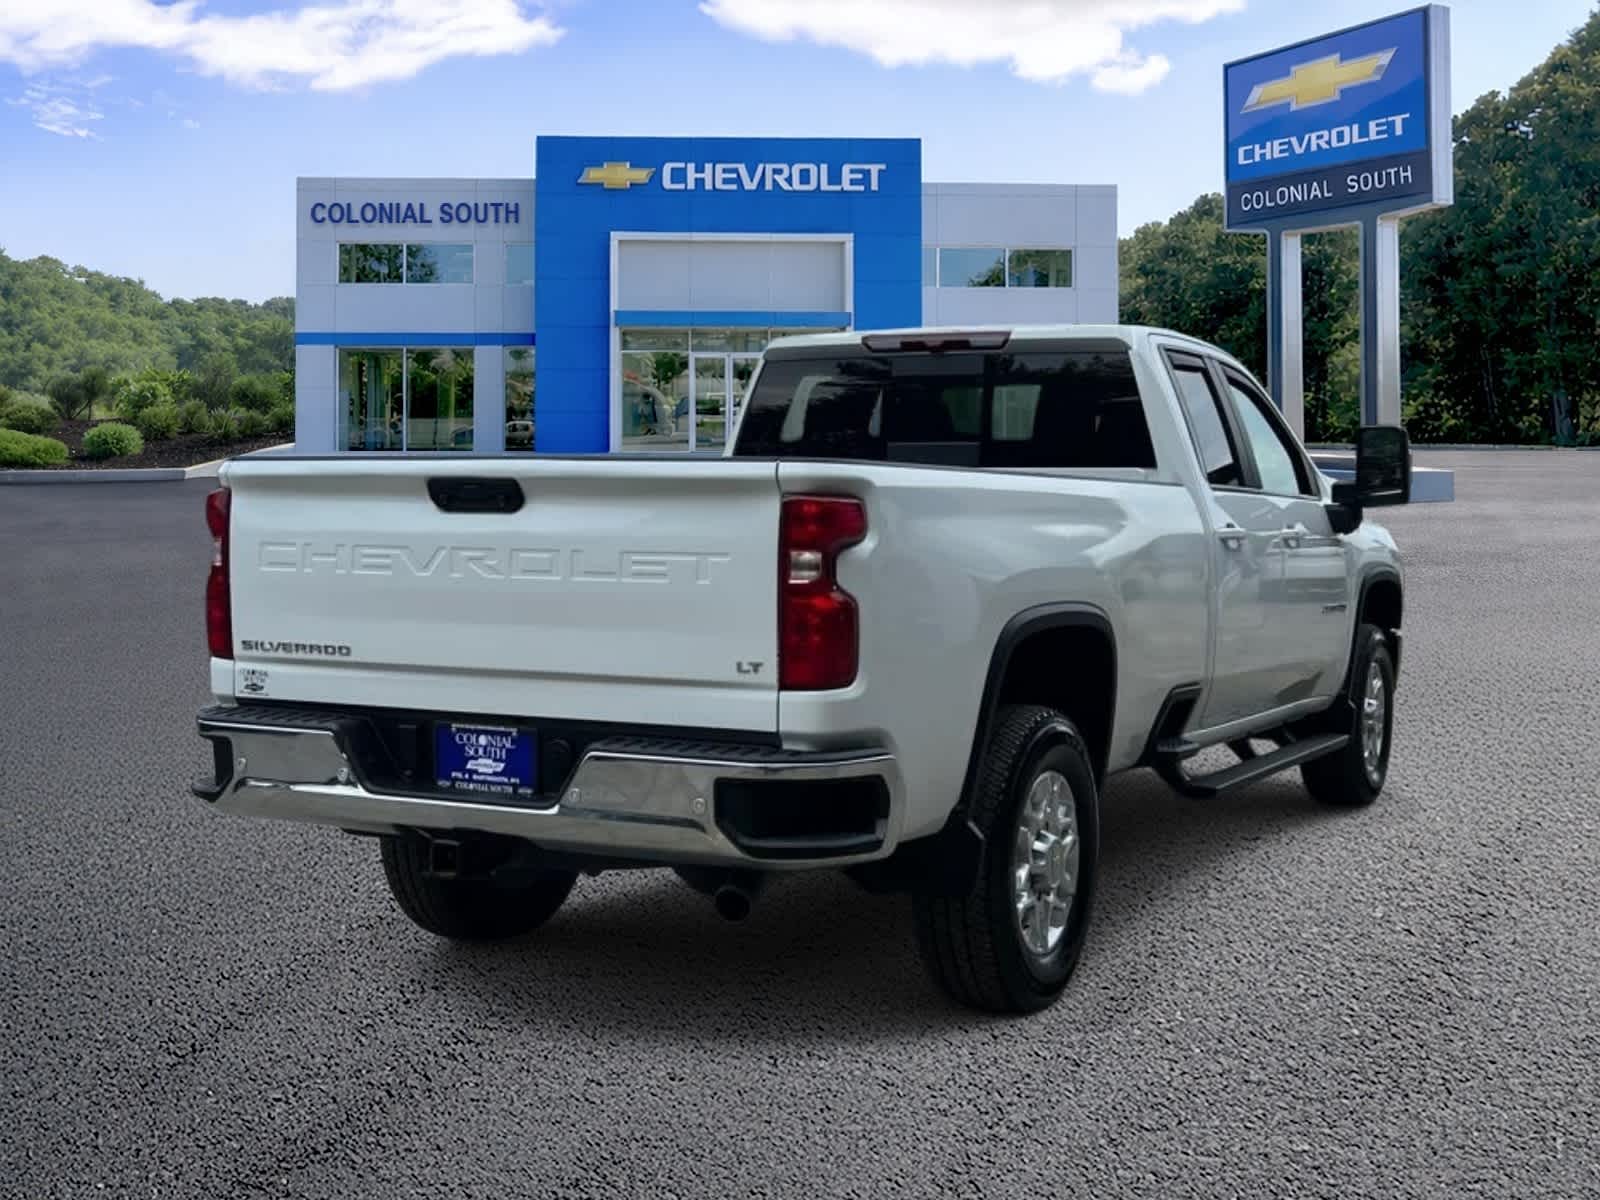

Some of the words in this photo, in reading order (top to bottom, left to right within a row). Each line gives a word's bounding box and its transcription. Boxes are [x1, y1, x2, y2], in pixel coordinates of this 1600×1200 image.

[1237, 112, 1411, 166] CHEVROLET
[662, 162, 887, 192] CHEVROLET
[1240, 179, 1334, 212] COLONIAL
[1346, 164, 1413, 193] SOUTH
[310, 203, 433, 225] COLONIAL
[439, 202, 520, 225] SOUTH
[257, 541, 733, 585] CHEVROLET
[240, 639, 352, 657] SILVERADO
[736, 660, 763, 674] LT
[455, 732, 516, 749] COLONIAL
[464, 744, 506, 760] SOUTH
